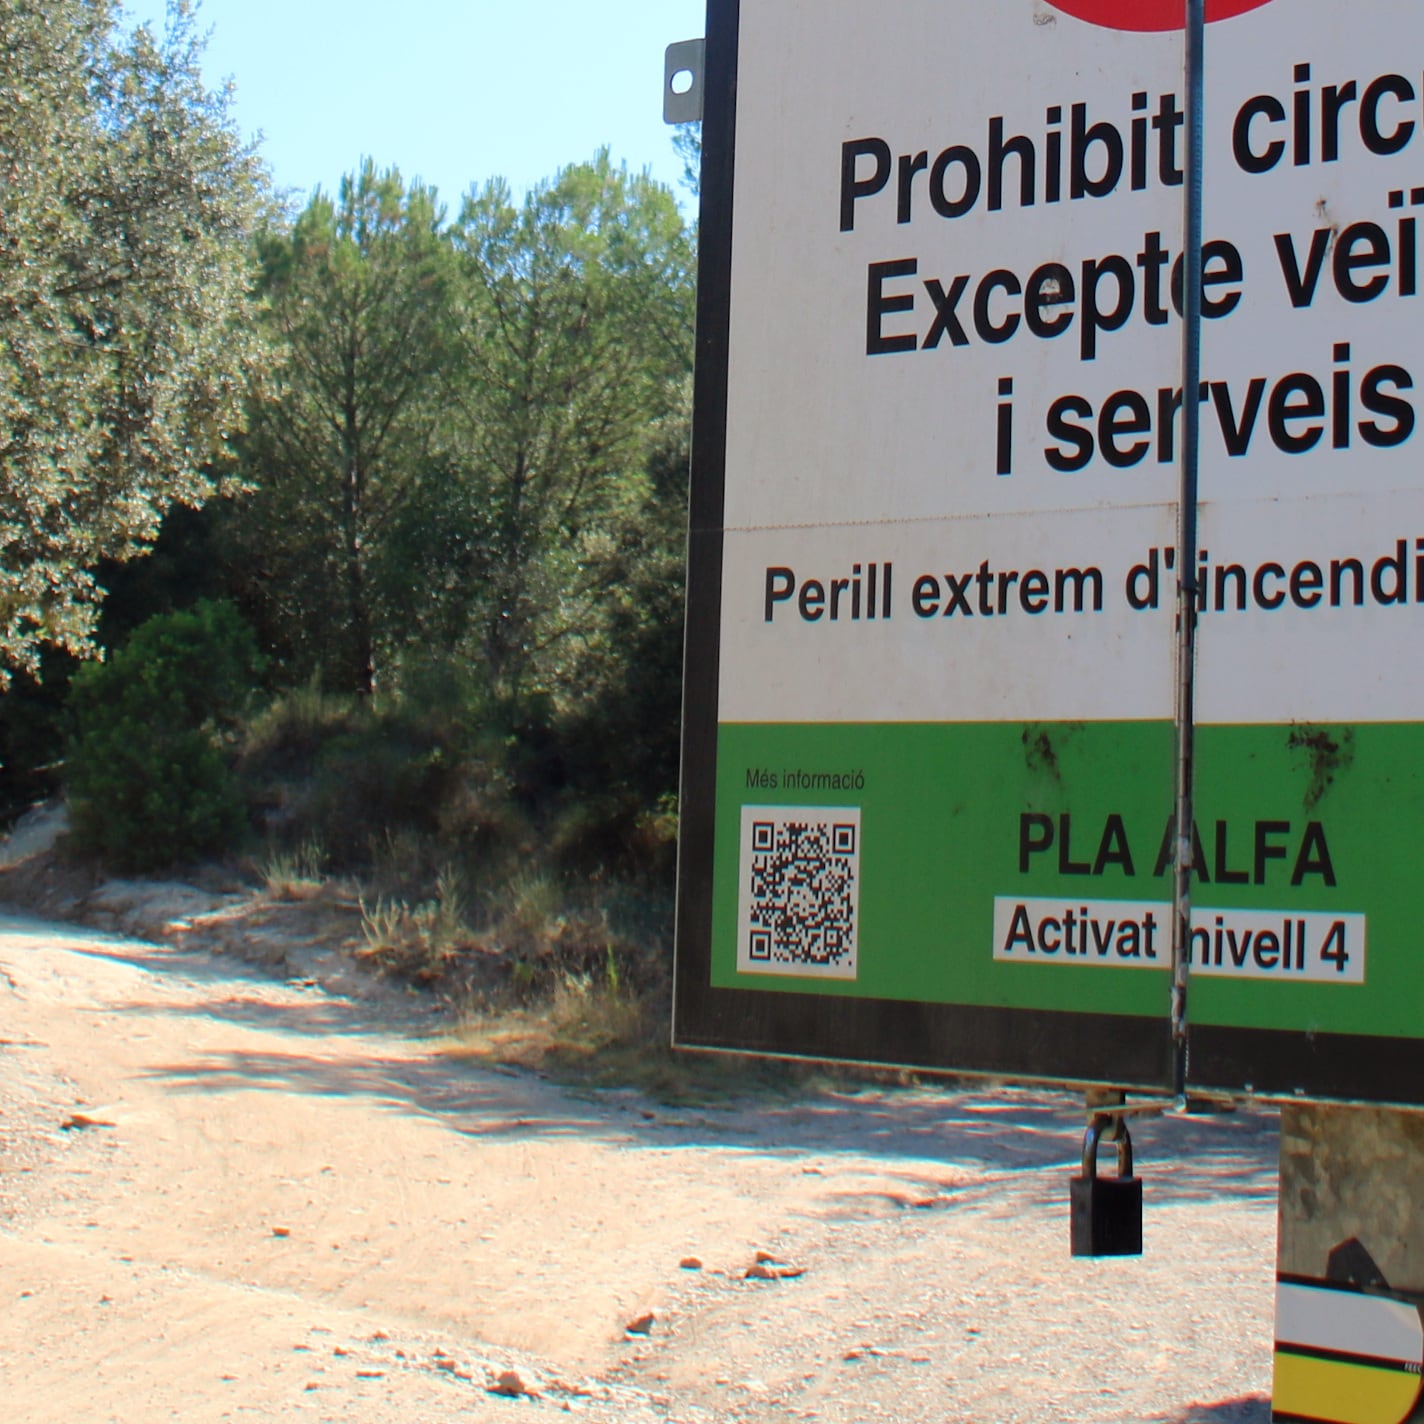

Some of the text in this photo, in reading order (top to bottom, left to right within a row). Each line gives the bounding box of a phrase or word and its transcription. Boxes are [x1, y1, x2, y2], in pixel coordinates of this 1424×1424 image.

[839, 92, 1184, 232] Prohibit
[866, 228, 1243, 361] Excepte
[996, 342, 1415, 476] i serveis
[764, 562, 893, 622] Perill
[911, 559, 1103, 619] extrem
[745, 767, 865, 791] Més informació
[1019, 812, 1337, 887] PLA ALFA
[1004, 904, 1349, 972] Activat nivell 4
